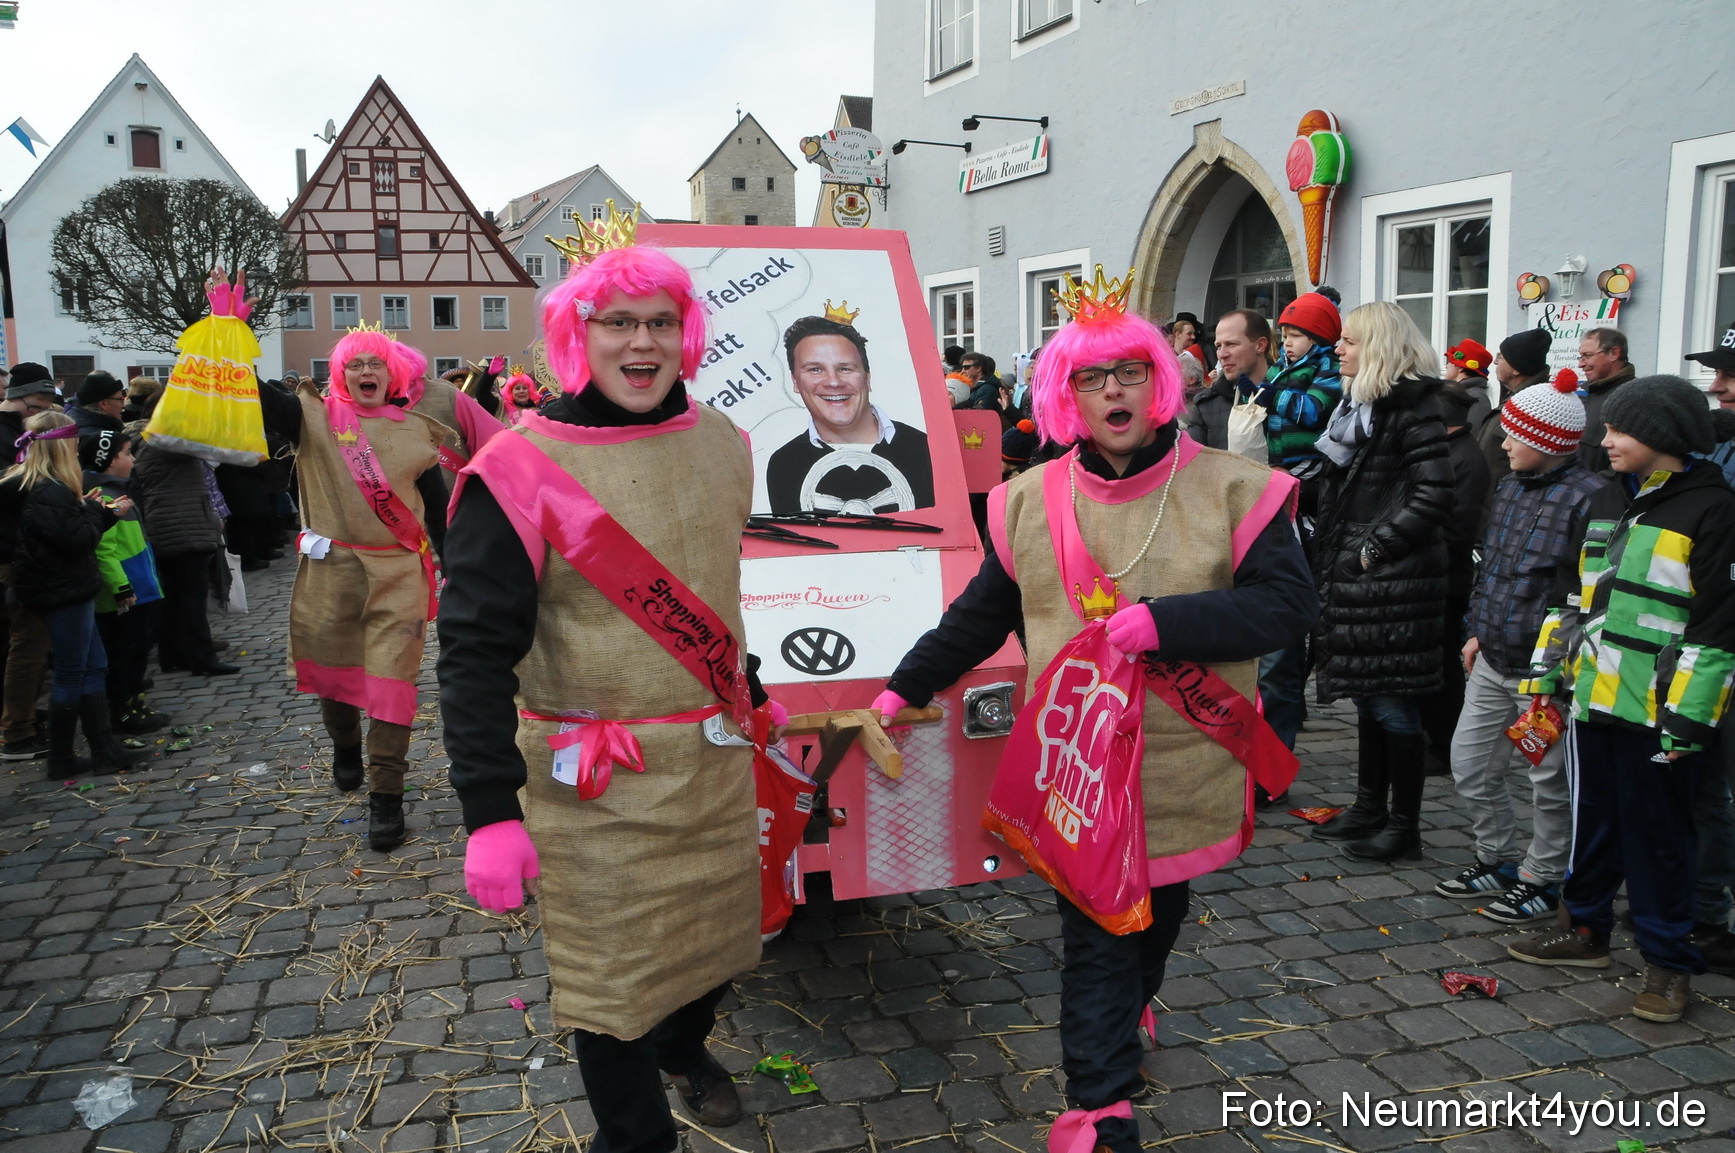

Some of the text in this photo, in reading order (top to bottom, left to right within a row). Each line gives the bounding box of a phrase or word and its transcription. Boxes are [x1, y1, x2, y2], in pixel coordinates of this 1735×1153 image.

[835, 129, 868, 140] Pizzeria
[843, 141, 860, 150] Café
[834, 151, 868, 162] Eisdiele
[975, 154, 993, 165] Pizzeria
[972, 161, 1030, 186] Bella Roma
[1537, 303, 1590, 332] & Eis
[740, 588, 870, 610] Shopping Queen
[648, 578, 716, 646] Shopping
[1035, 736, 1105, 828] Jahre
[1043, 787, 1082, 846] NKD
